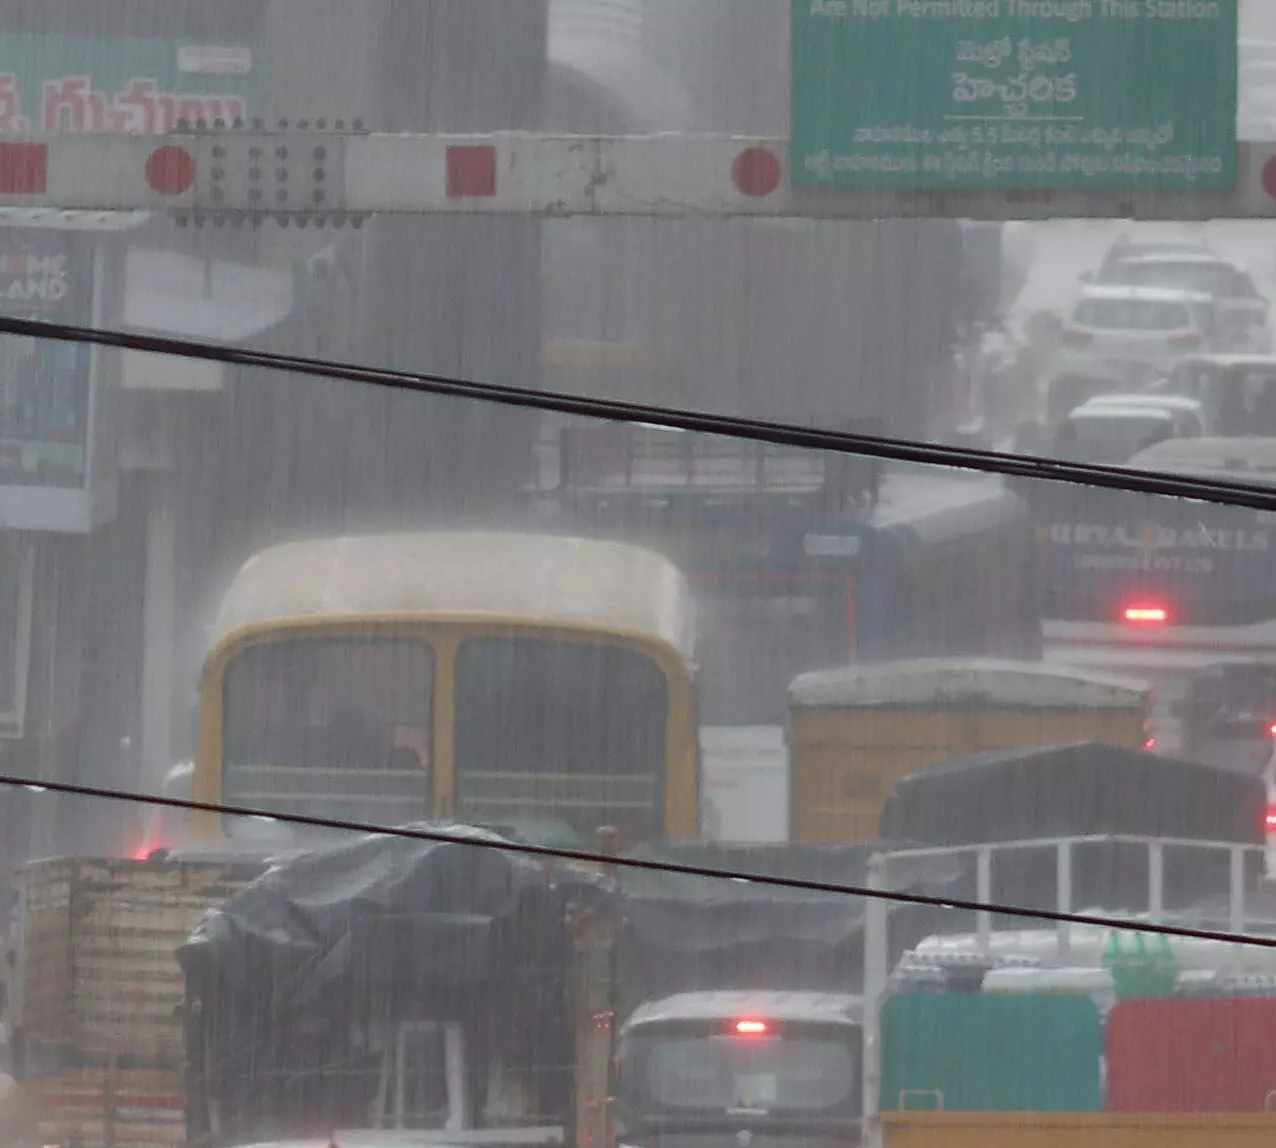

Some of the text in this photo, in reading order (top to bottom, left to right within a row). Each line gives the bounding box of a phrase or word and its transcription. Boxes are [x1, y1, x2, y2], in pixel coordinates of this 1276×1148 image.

[810, 0, 1221, 22] Are Not Permitted Through This Station
[971, 127, 998, 145] 5.5
